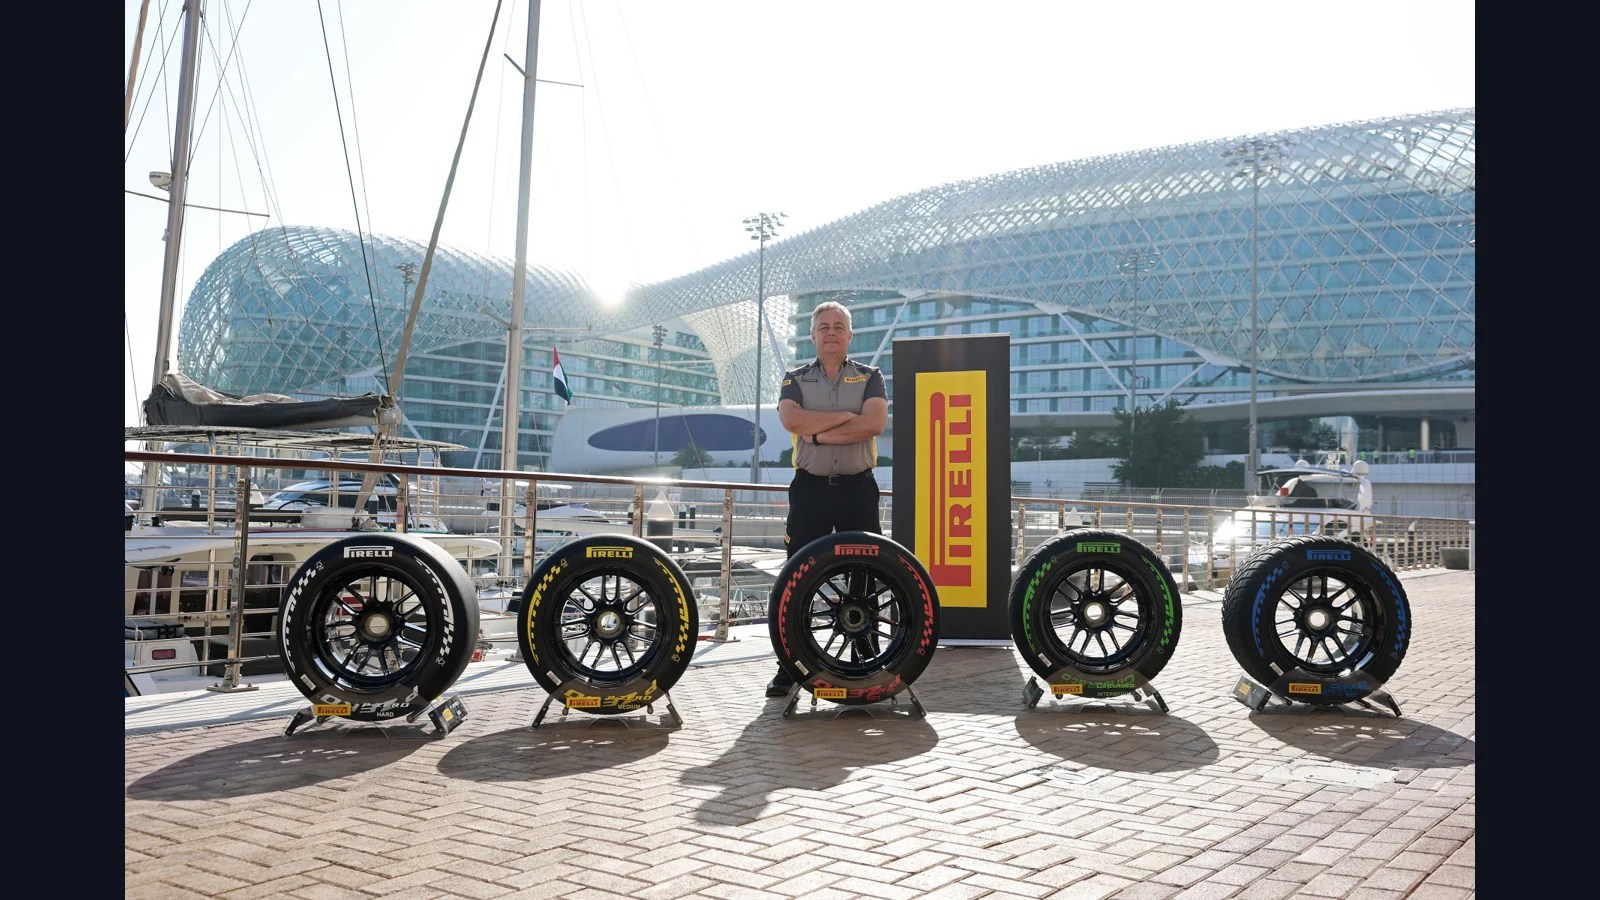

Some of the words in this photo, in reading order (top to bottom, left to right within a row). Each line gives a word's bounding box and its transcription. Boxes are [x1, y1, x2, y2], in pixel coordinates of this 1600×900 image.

[930, 392, 972, 586] PIRELLI
[344, 546, 394, 558] PIRELLI
[586, 546, 633, 558] PIRELLI
[834, 544, 879, 555] PIRELLI
[1077, 542, 1120, 553] PIRELLI
[1306, 550, 1351, 560] PIRELLI
[816, 689, 844, 697] PIRELLI
[1053, 685, 1080, 693] PIRELLI
[569, 698, 599, 706] PIRELLI
[317, 706, 348, 714] PIRELLI
